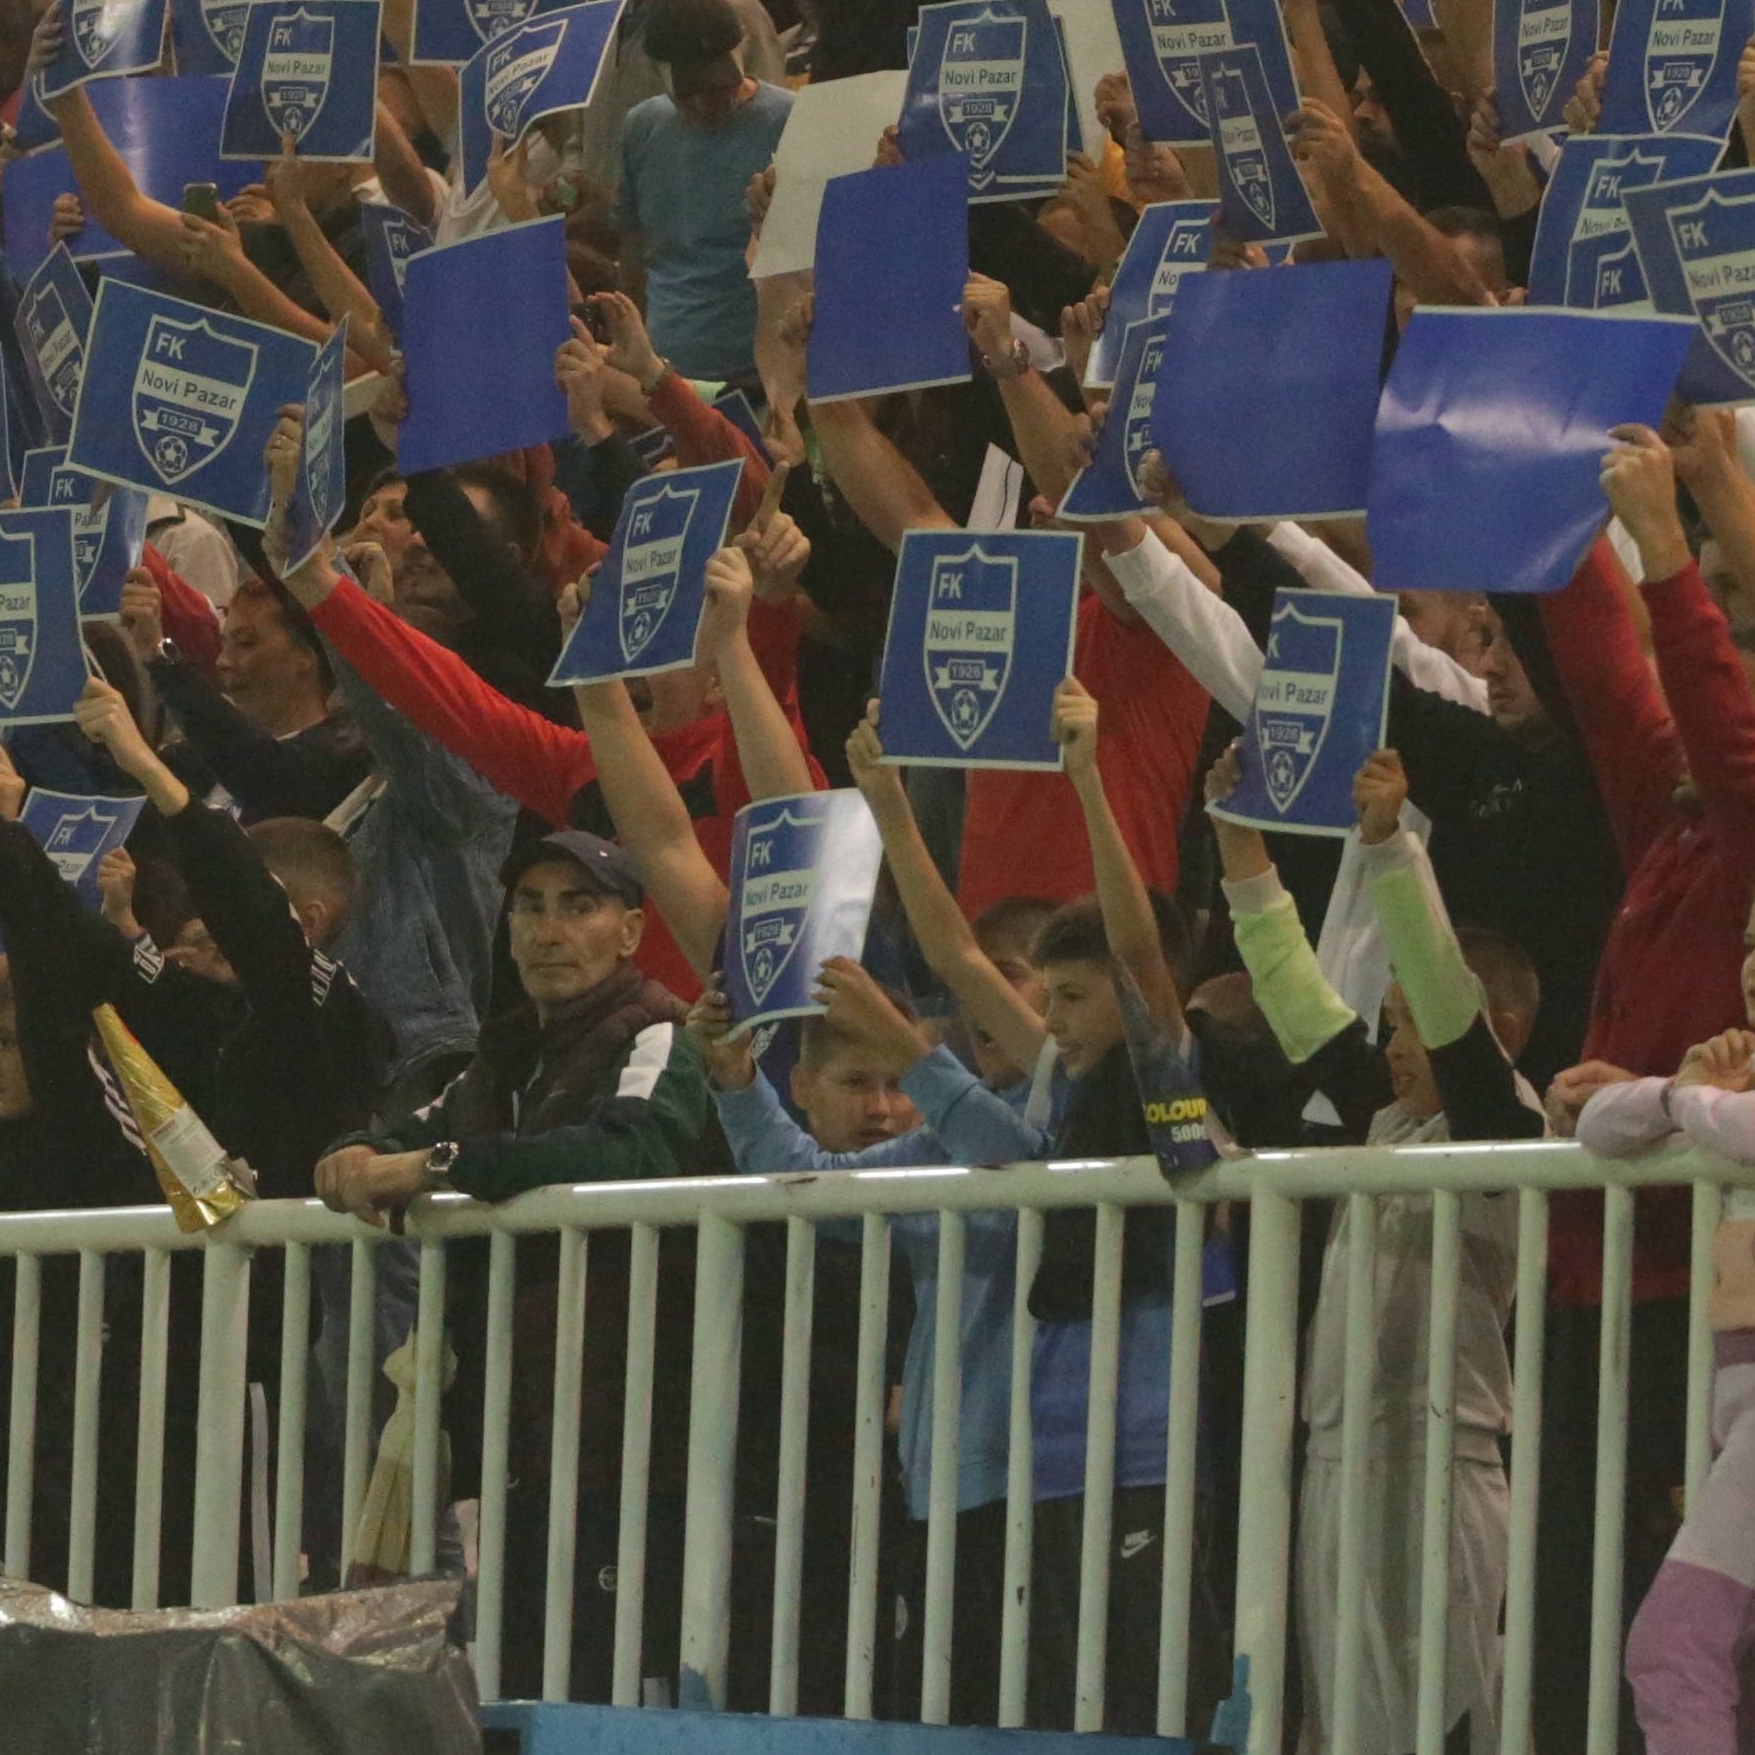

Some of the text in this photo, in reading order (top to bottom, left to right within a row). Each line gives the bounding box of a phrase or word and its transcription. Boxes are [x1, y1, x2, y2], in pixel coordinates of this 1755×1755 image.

[1543, 15, 1569, 33] Pazar
[273, 27, 294, 46] FK
[952, 32, 976, 53] FK
[1156, 30, 1227, 49] Novi Pazar
[1653, 29, 1716, 46] Novi Pazar
[266, 60, 327, 76] Novi Pazar
[493, 46, 513, 70] FK
[944, 67, 1017, 86] Novi Pazar
[964, 101, 993, 115] 1928
[1596, 174, 1620, 196] FK
[1580, 216, 1610, 234] Novi
[1680, 223, 1707, 247] FK
[1174, 233, 1199, 253] FK
[1602, 269, 1622, 294] FK
[1690, 268, 1720, 289] Novi
[155, 333, 187, 358] FK
[142, 369, 237, 410] Novi Pazar
[158, 412, 200, 432] 1928
[56, 478, 75, 497] FK
[633, 511, 651, 535] FK
[625, 547, 677, 574] Novi Pazar
[938, 572, 962, 598] FK
[929, 622, 1007, 642] Novi Pazar
[949, 662, 982, 679] 1928
[1286, 685, 1326, 705] Pazar
[1268, 724, 1301, 743] 1928
[750, 839, 772, 866] FK
[744, 881, 808, 909] Novi Pazar
